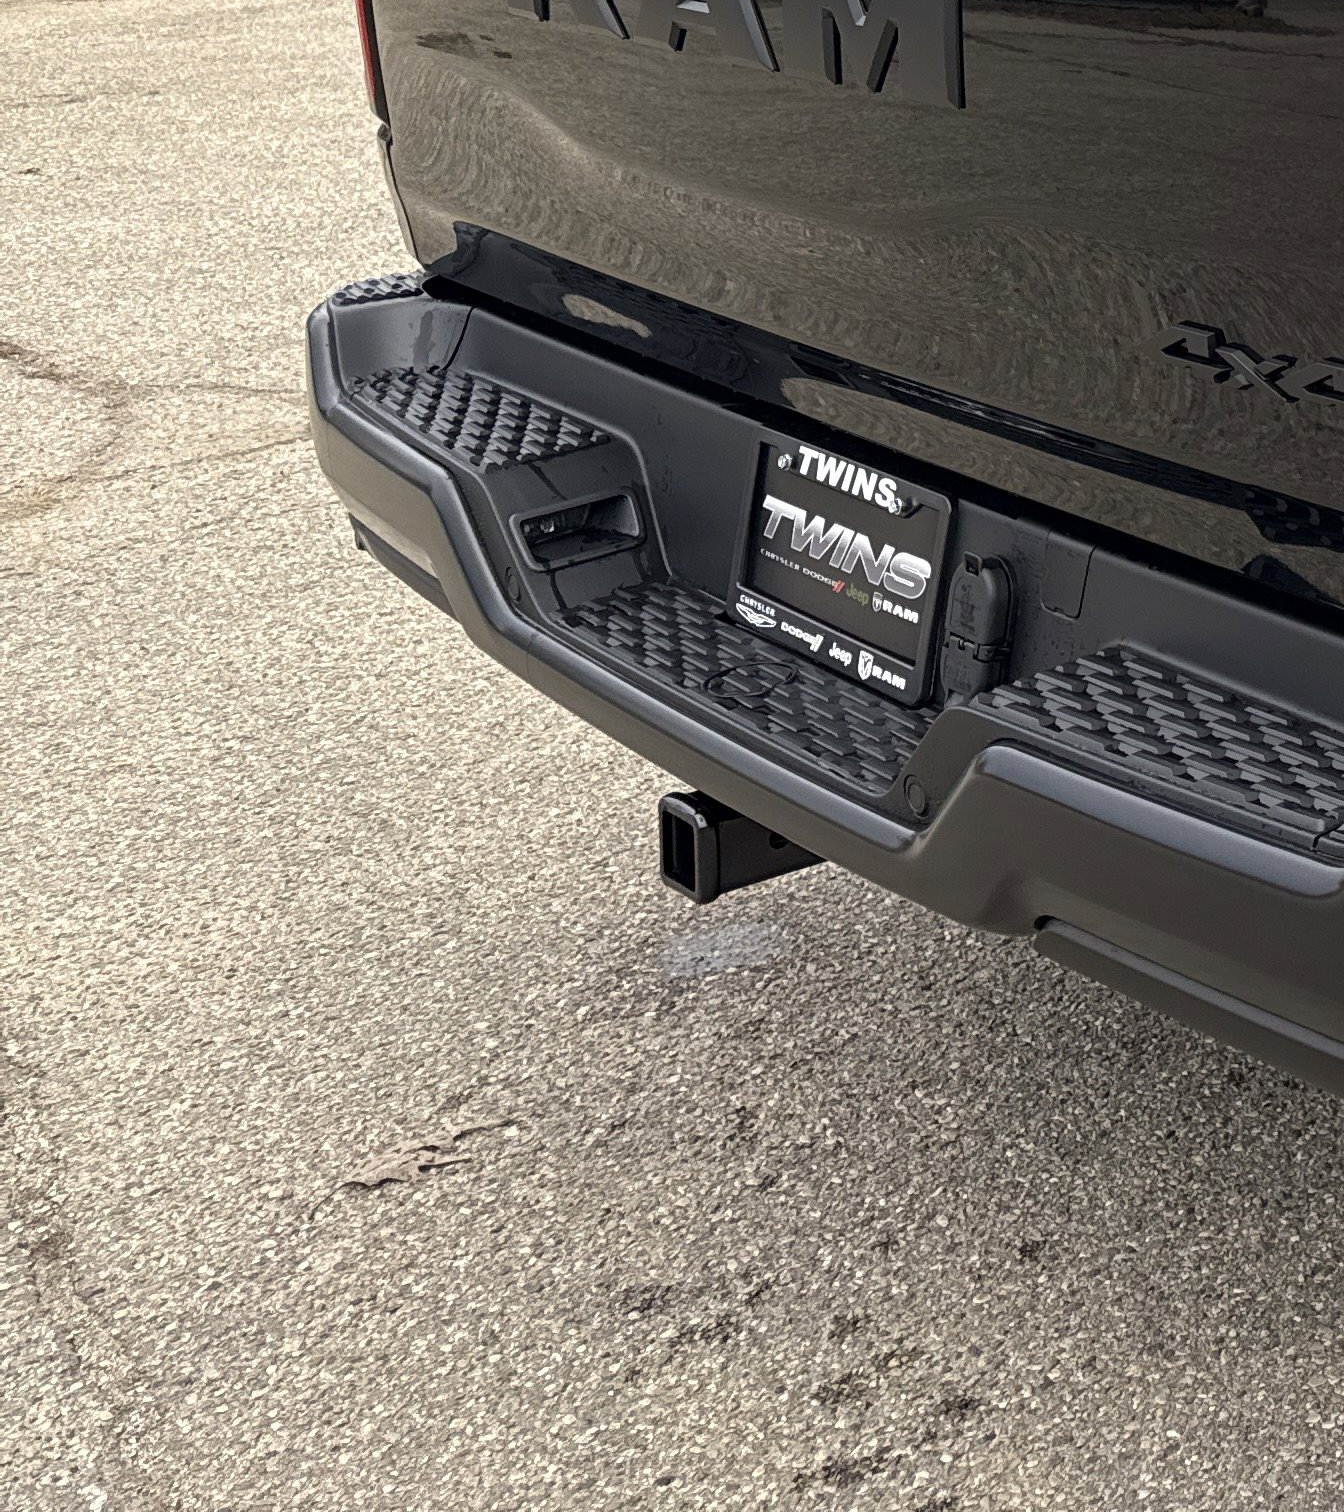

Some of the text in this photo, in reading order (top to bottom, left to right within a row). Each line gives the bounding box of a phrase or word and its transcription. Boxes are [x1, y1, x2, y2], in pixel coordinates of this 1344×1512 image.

[798, 445, 898, 512] TWINS
[762, 494, 932, 599] TWINS
[739, 594, 776, 617] CHRYSLER
[760, 548, 800, 571] CHRYSLER
[845, 584, 869, 606] Jeep
[882, 599, 919, 624] RAM
[828, 642, 853, 667] Jeep
[872, 665, 906, 691] RAM
